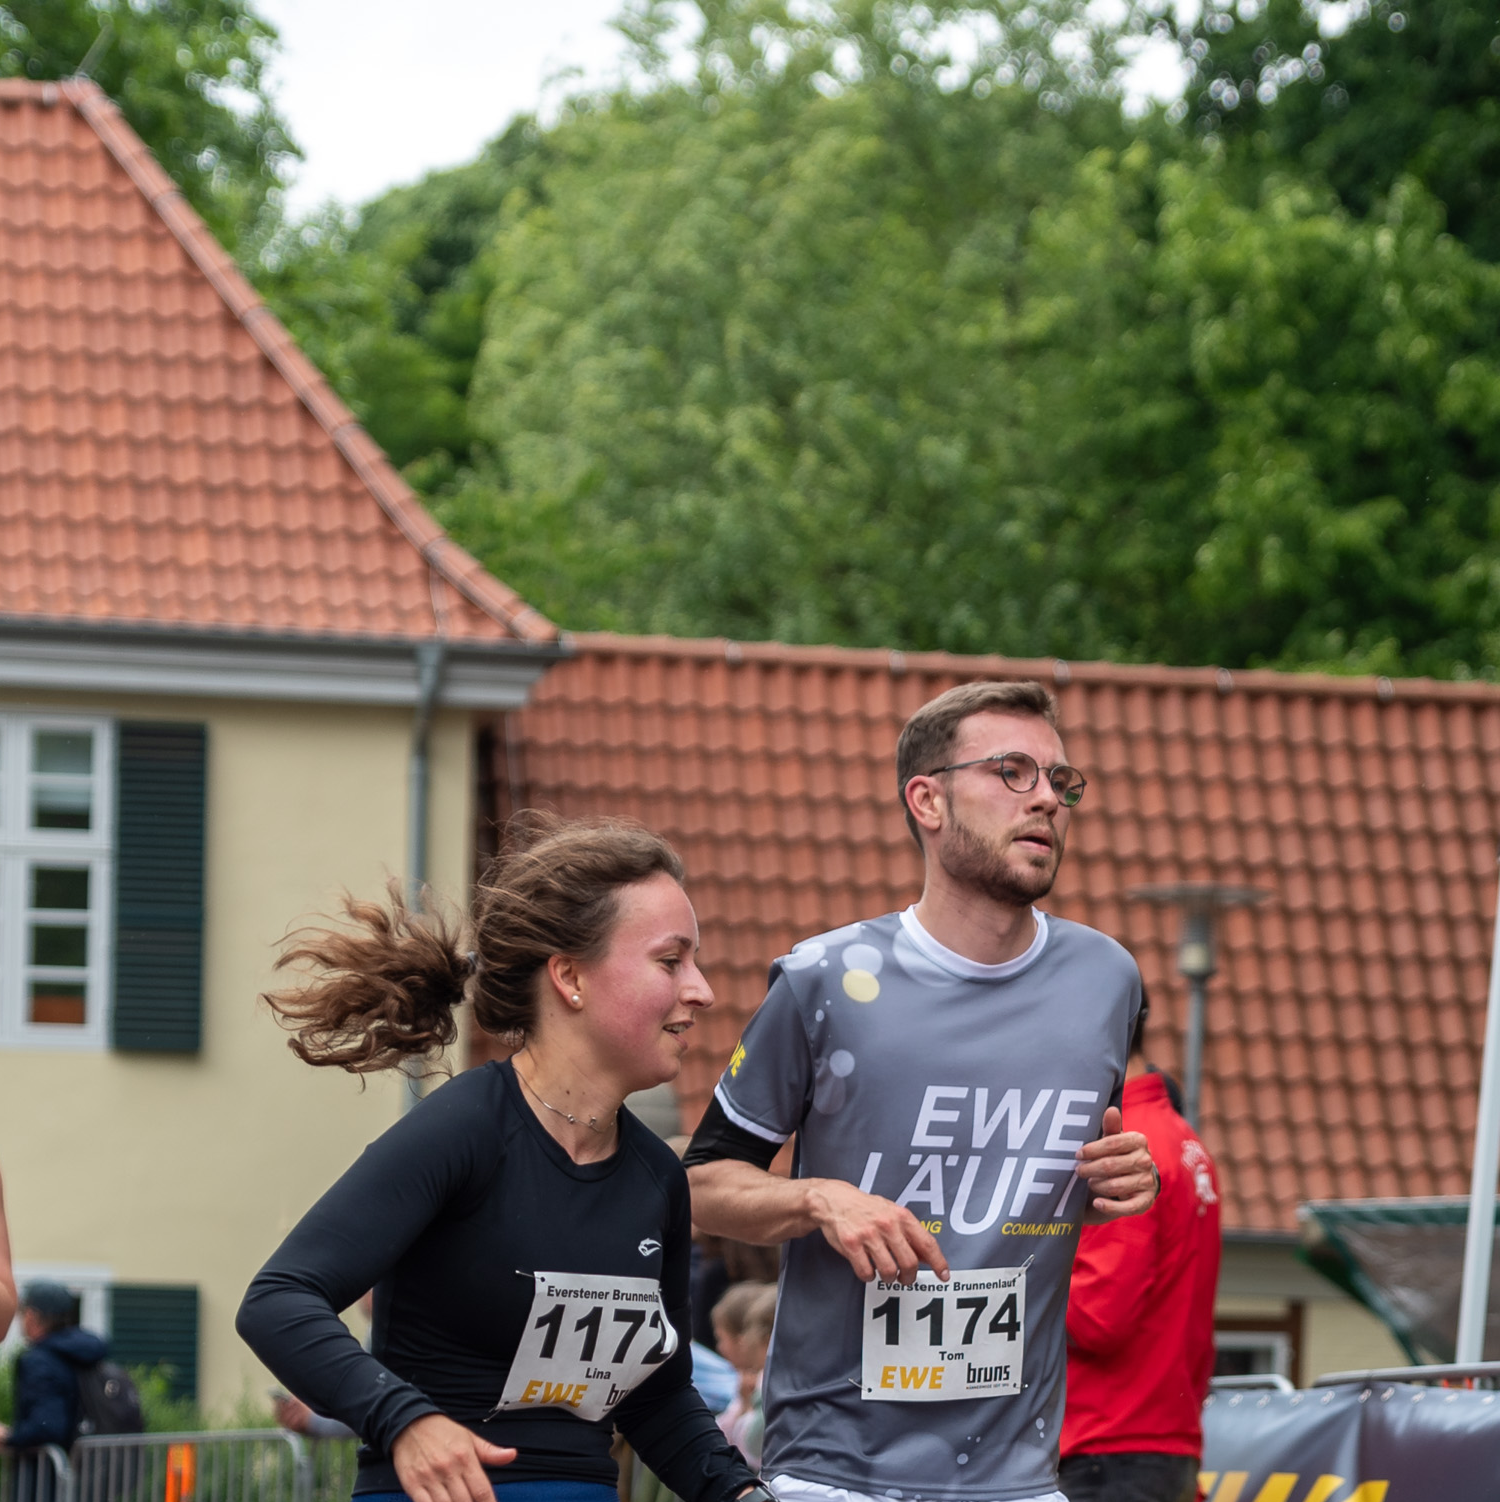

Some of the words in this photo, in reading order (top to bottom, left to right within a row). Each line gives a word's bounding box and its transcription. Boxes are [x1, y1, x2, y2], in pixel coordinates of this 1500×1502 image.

[910, 1085, 1099, 1152] EWE
[1001, 1222, 1075, 1236] COMMUNITY
[546, 1285, 610, 1300] Everstener
[612, 1289, 659, 1304] Brunnenla
[953, 1279, 1016, 1291] Brunnenlauf
[872, 1293, 1021, 1347] 1174
[534, 1303, 674, 1364] 1172
[939, 1351, 964, 1361] Tom
[585, 1367, 611, 1380] Lina
[880, 1366, 945, 1390] EWE
[966, 1362, 1010, 1383] bruns
[519, 1379, 588, 1408] EWE
